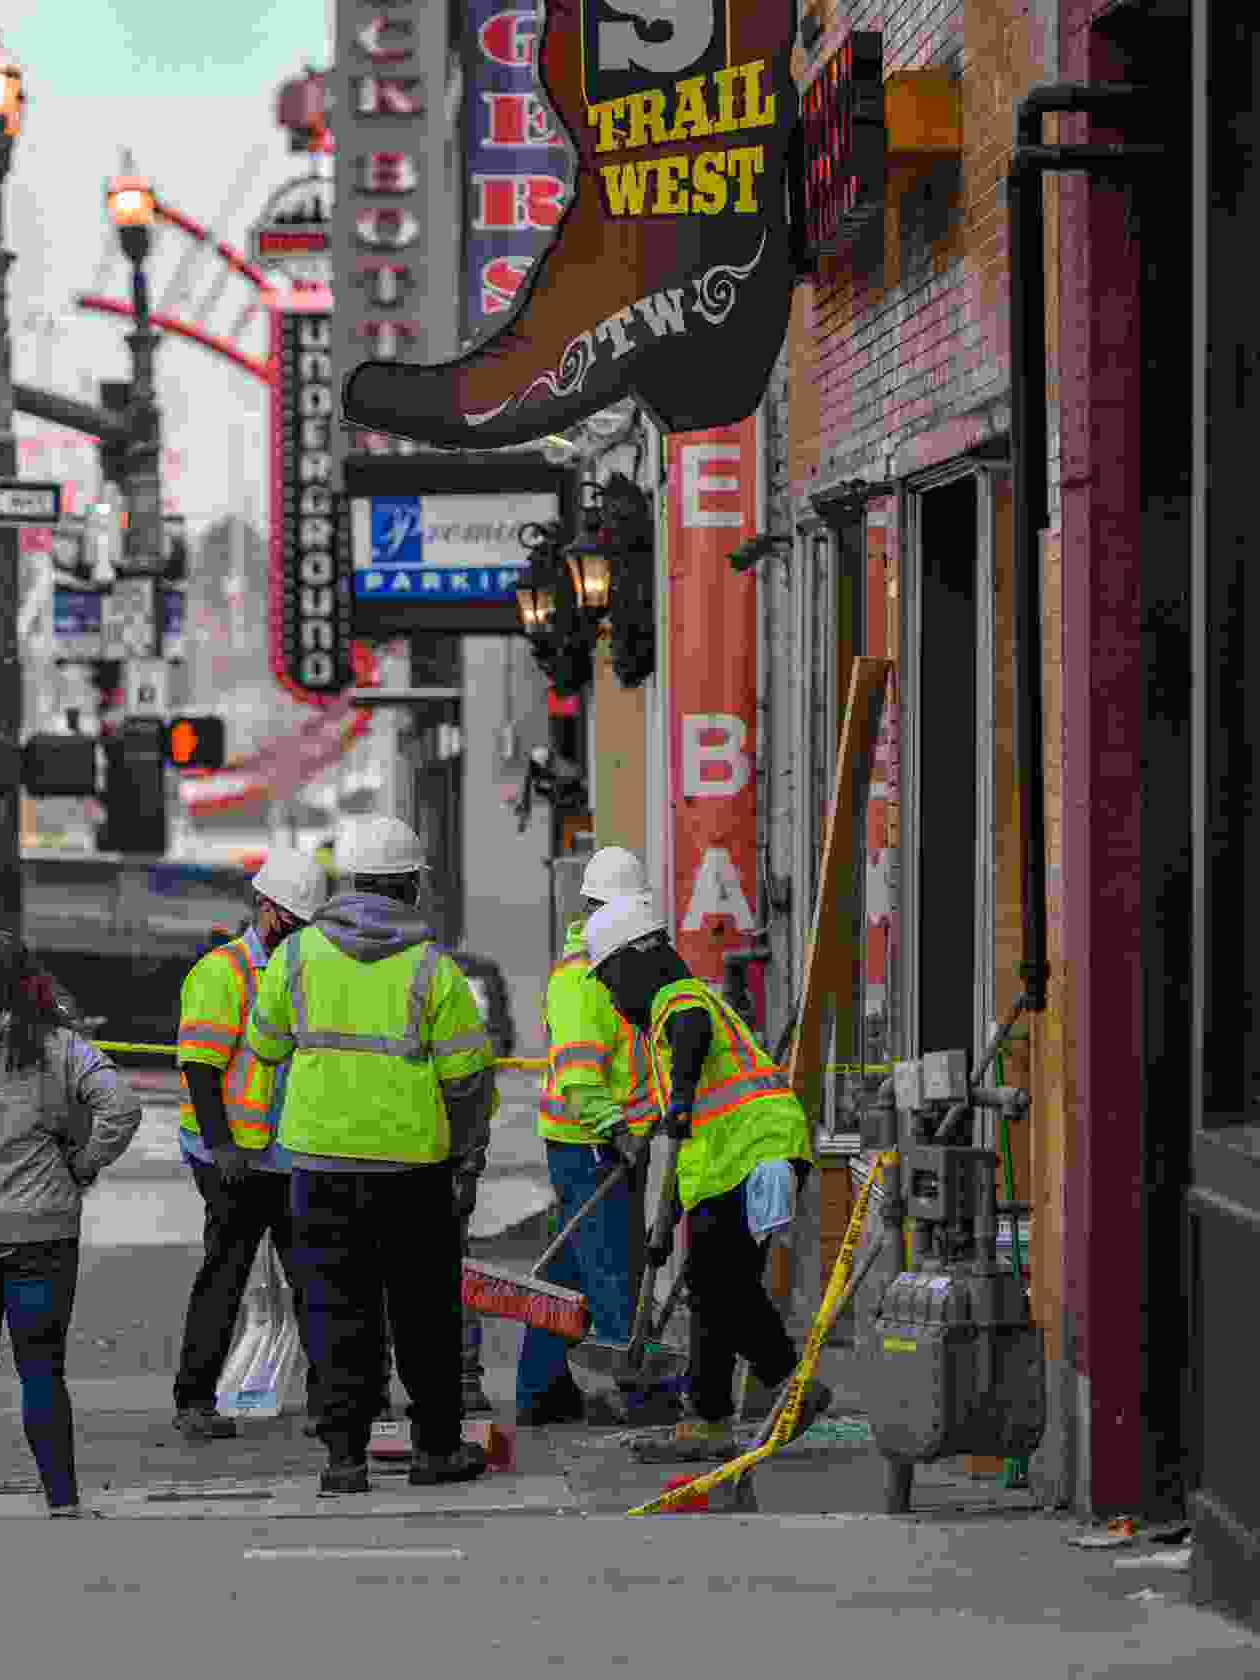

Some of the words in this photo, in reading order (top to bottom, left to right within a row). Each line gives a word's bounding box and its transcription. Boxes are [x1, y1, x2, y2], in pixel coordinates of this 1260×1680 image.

[588, 59, 780, 153] TRAIL
[600, 145, 765, 216] WEST
[300, 320, 333, 685] UNDERGROUND
